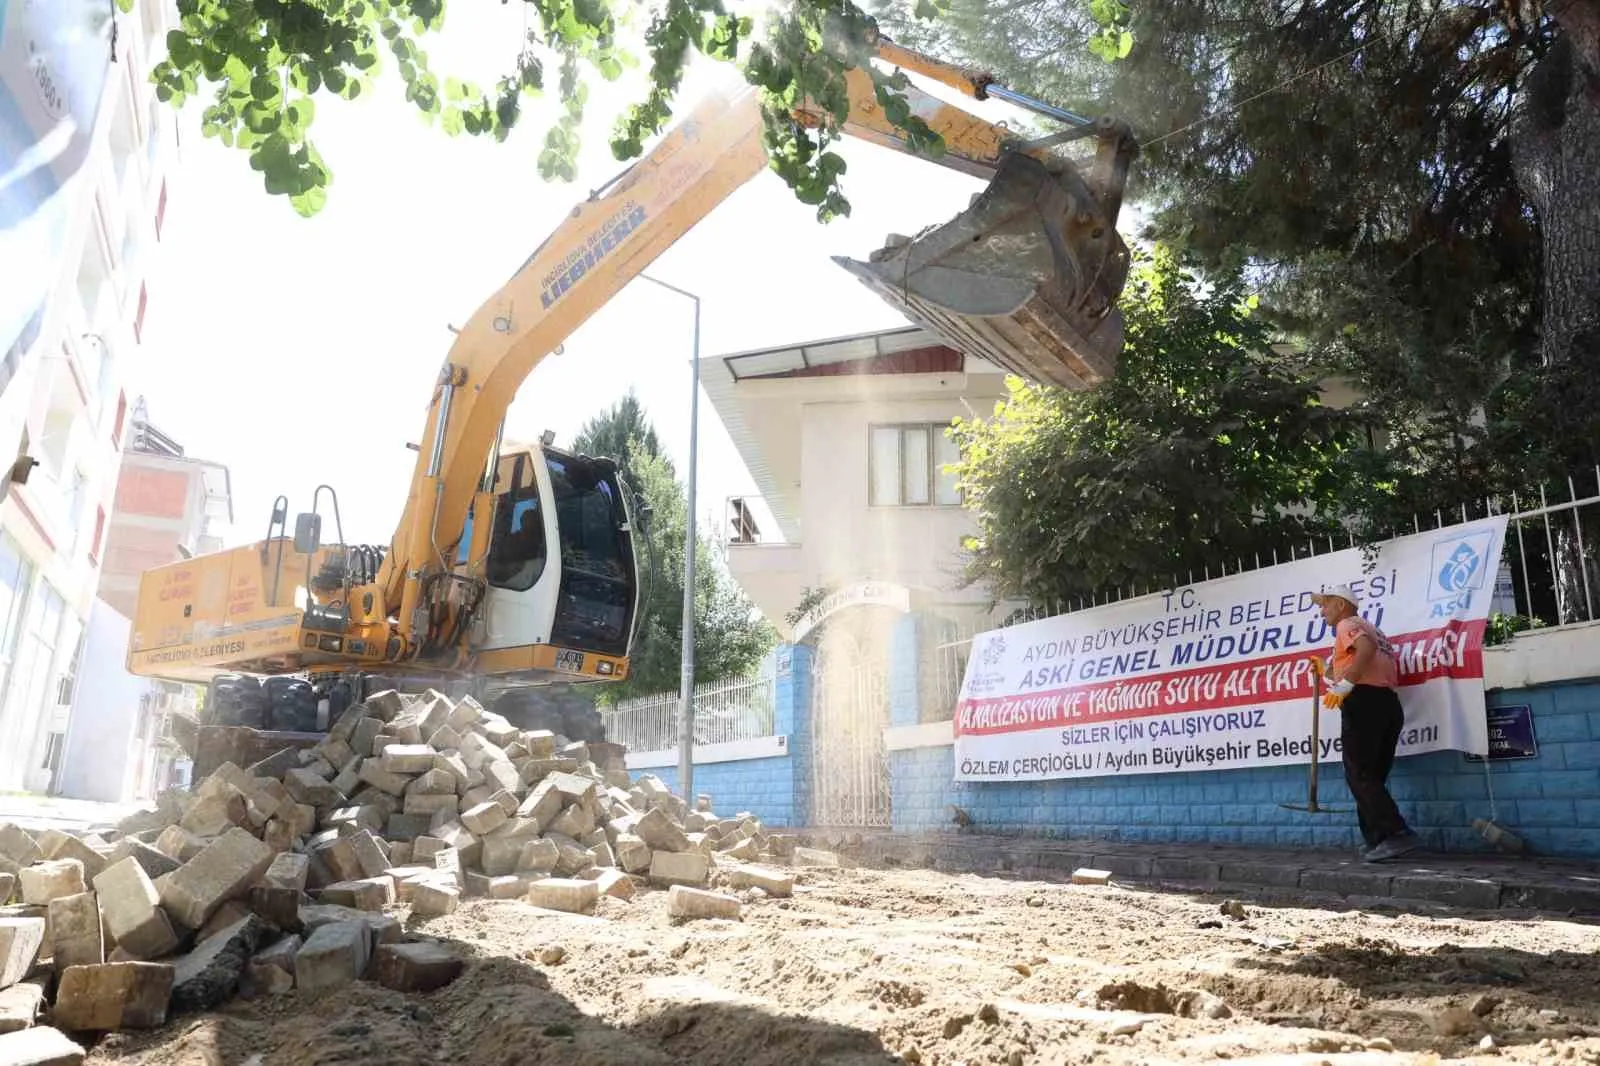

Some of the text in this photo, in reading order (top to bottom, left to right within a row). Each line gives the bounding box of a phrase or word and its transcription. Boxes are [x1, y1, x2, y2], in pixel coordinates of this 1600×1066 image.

[540, 205, 648, 310] LIEBHERR
[1023, 569, 1397, 664] AYDIN BÜYÜKŞEHİR BELEDİESİ
[1162, 588, 1201, 613] T.C.
[1019, 662, 1074, 690] ASKİ
[1080, 649, 1161, 681] GENEL
[1170, 603, 1384, 666] MÜDÜRLÜÜ
[1063, 691, 1083, 719] VE
[1088, 680, 1162, 716] YAĞMUR
[1165, 671, 1222, 706] SUYU
[1062, 710, 1266, 747] SİZLER İÇİN ÇALIŞIYORUZ
[961, 757, 1009, 776] ÖZLEM
[1012, 752, 1093, 778] ÇERÇİOĞLU
[1105, 749, 1148, 771] Aydın
[1152, 739, 1251, 770] Büyükşehir
[1257, 735, 1343, 759] Beledye
